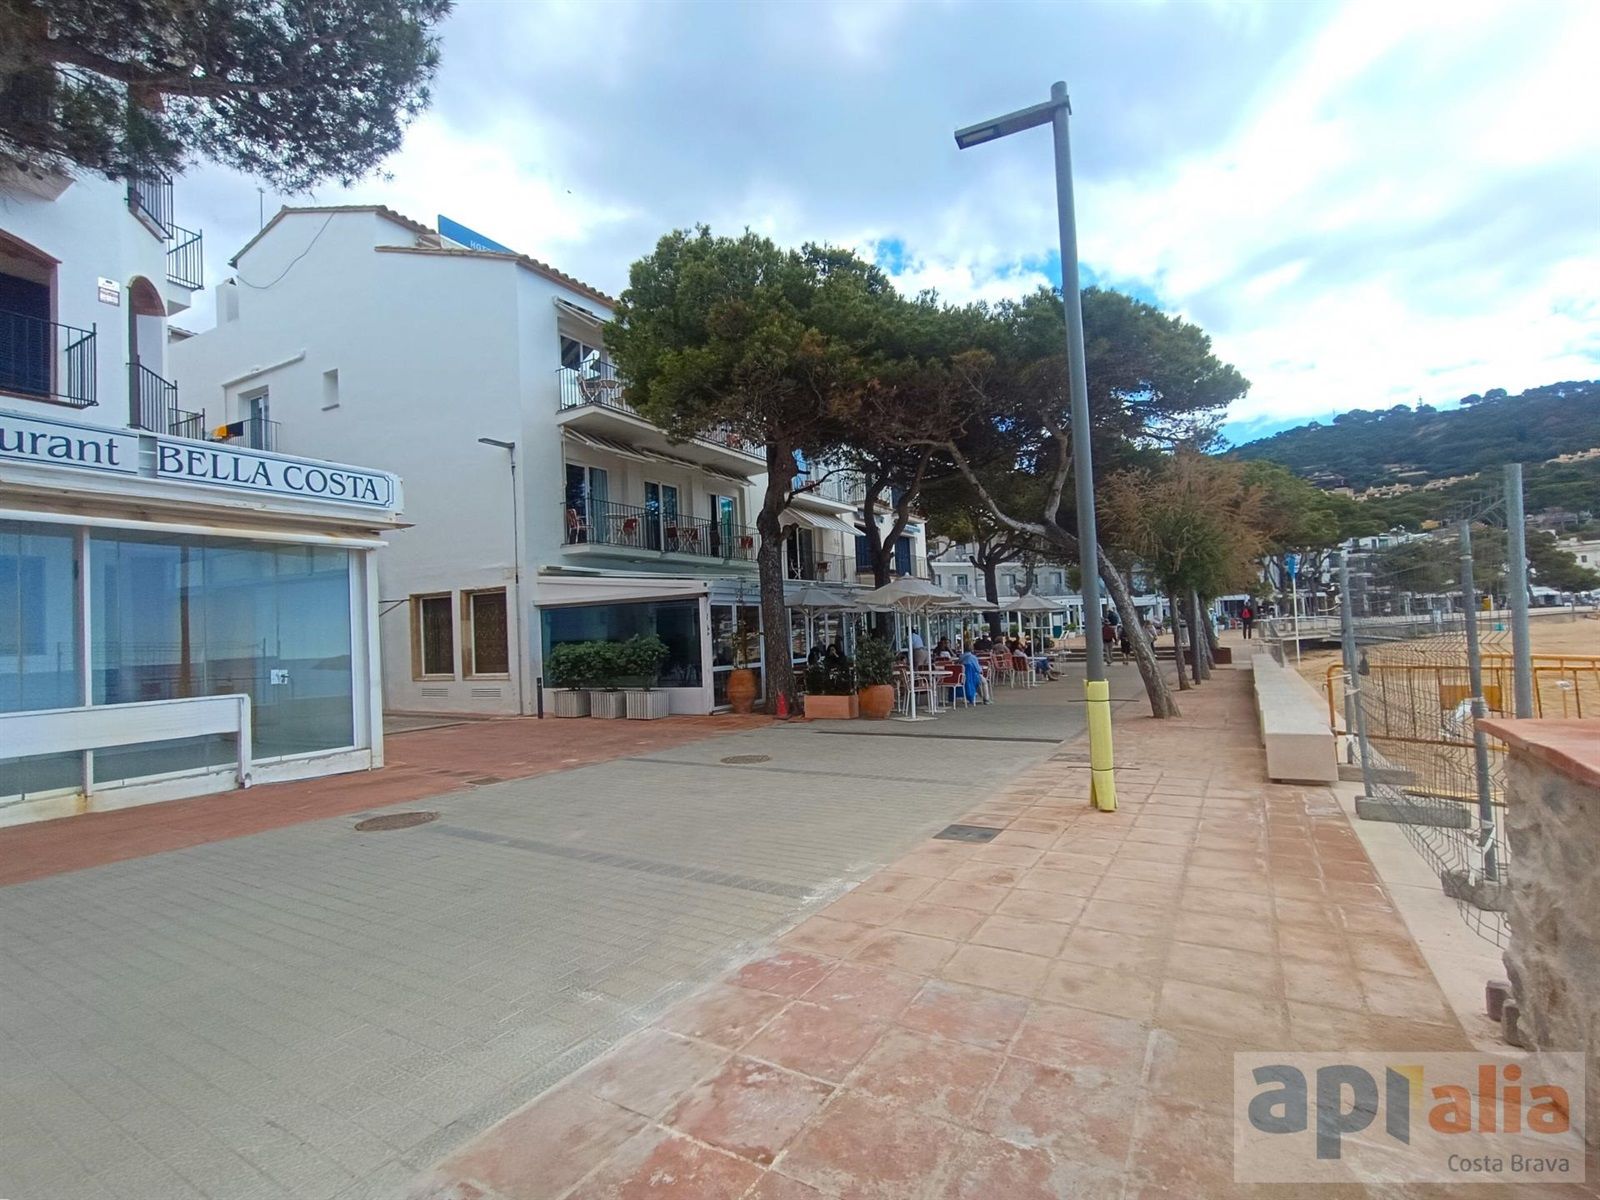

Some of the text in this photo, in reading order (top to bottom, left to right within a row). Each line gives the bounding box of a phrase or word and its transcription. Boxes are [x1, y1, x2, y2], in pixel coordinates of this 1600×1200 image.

[0, 428, 379, 501] urant BELLA COSTA
